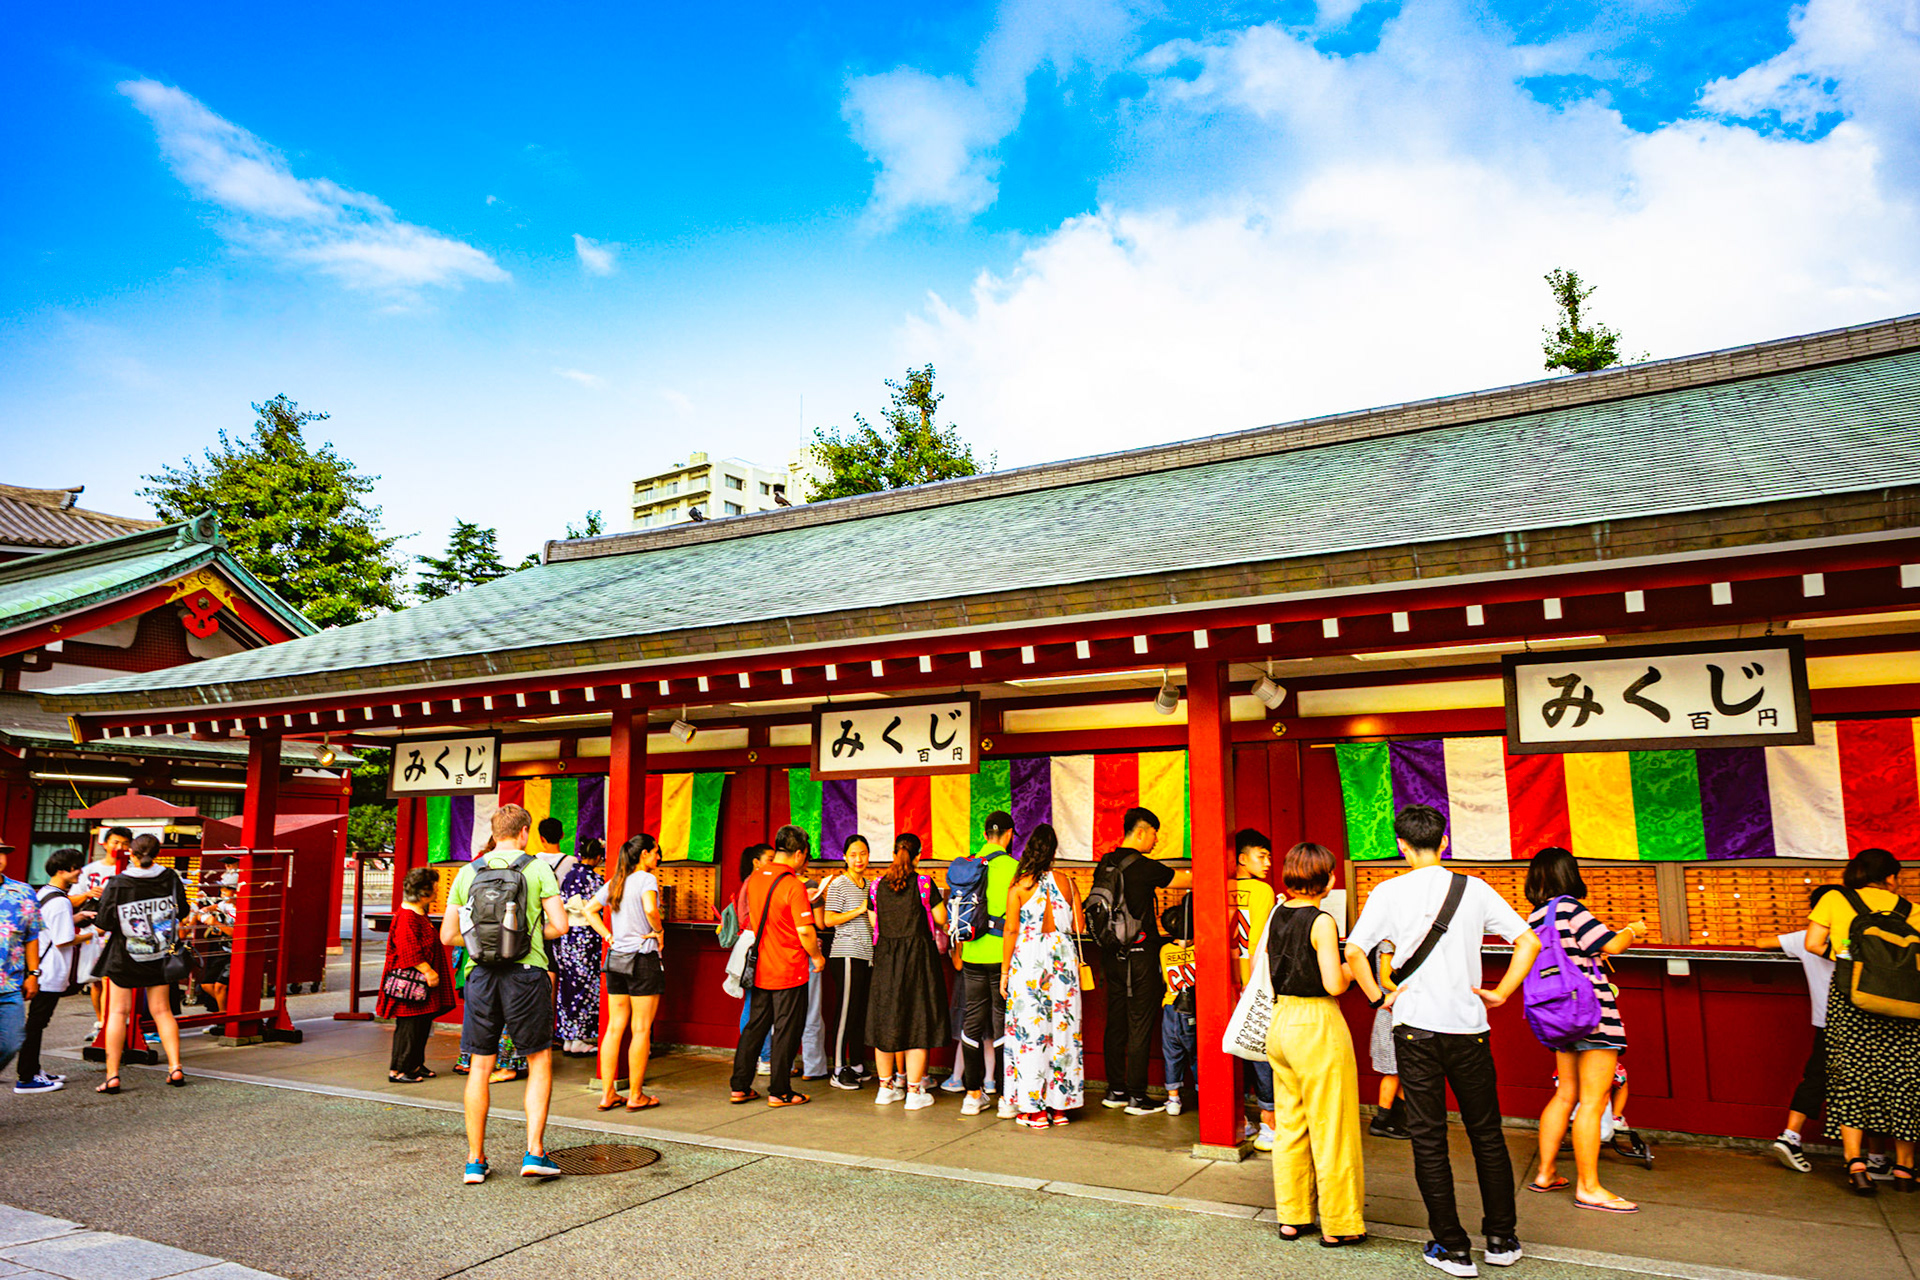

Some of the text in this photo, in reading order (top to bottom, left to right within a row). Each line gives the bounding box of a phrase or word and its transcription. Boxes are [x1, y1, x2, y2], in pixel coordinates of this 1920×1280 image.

[1542, 662, 1764, 728] みくじ
[832, 709, 962, 758] みくじ
[404, 745, 486, 782] みくじ
[121, 898, 175, 919] FASHION
[1167, 952, 1192, 962] READY
[1235, 1036, 1261, 1053] Seattle
